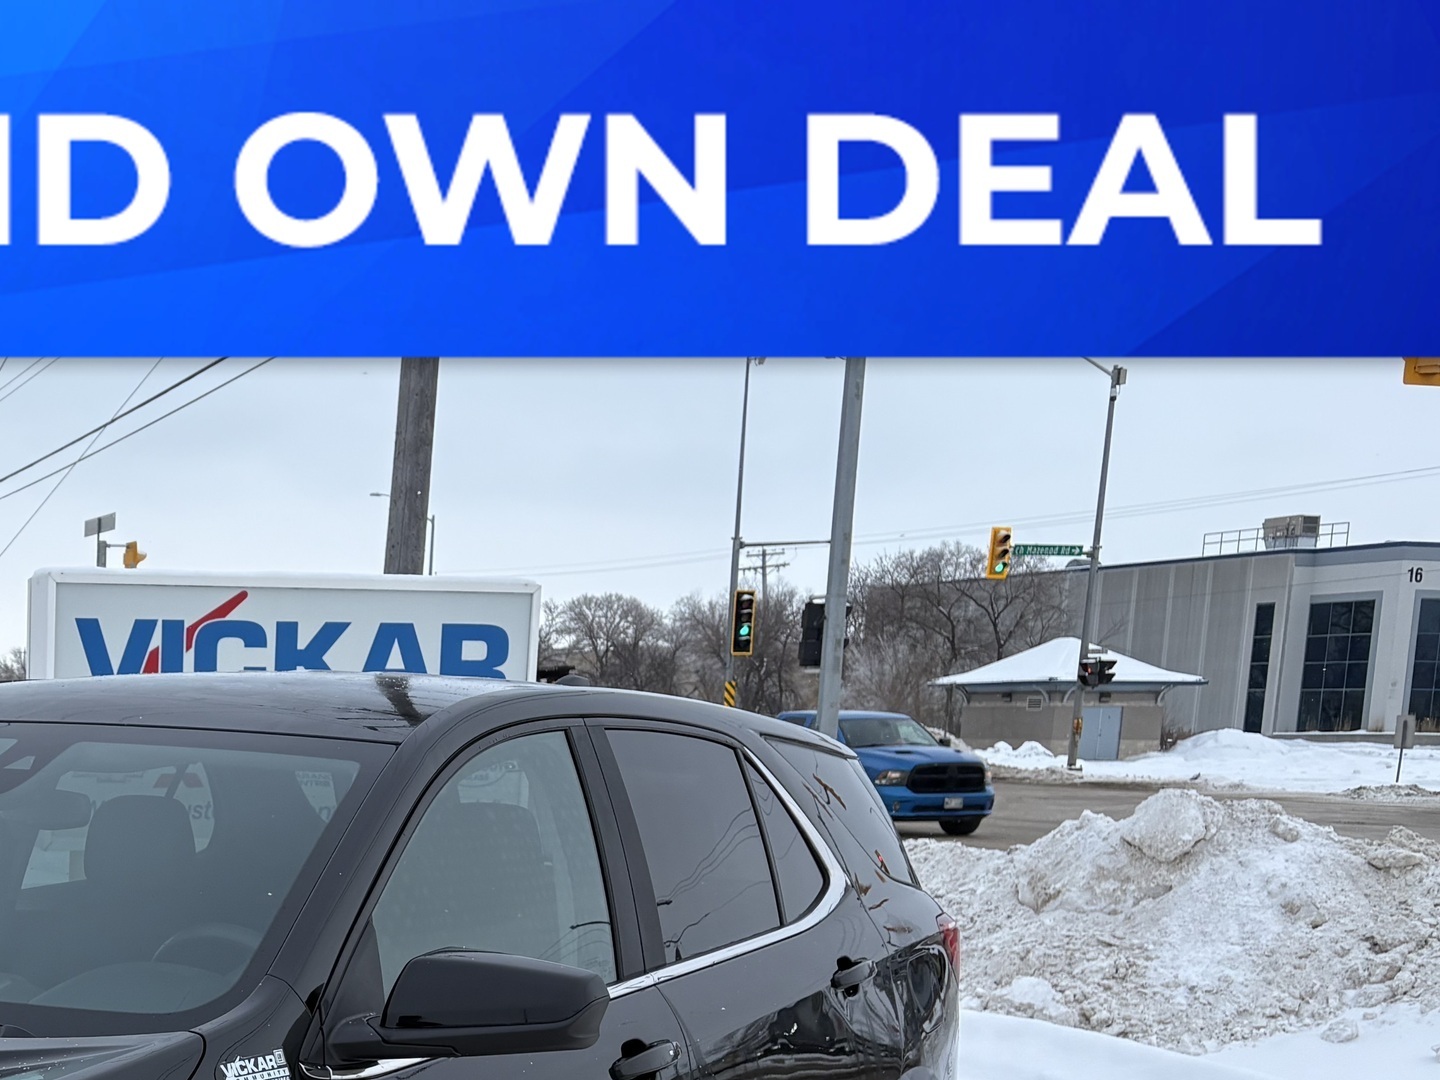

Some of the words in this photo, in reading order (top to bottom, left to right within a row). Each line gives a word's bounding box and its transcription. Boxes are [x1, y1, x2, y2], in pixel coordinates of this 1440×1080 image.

[1407, 566, 1423, 583] 16
[74, 618, 510, 681] VICKAR
[220, 1054, 278, 1078] VICKAR
